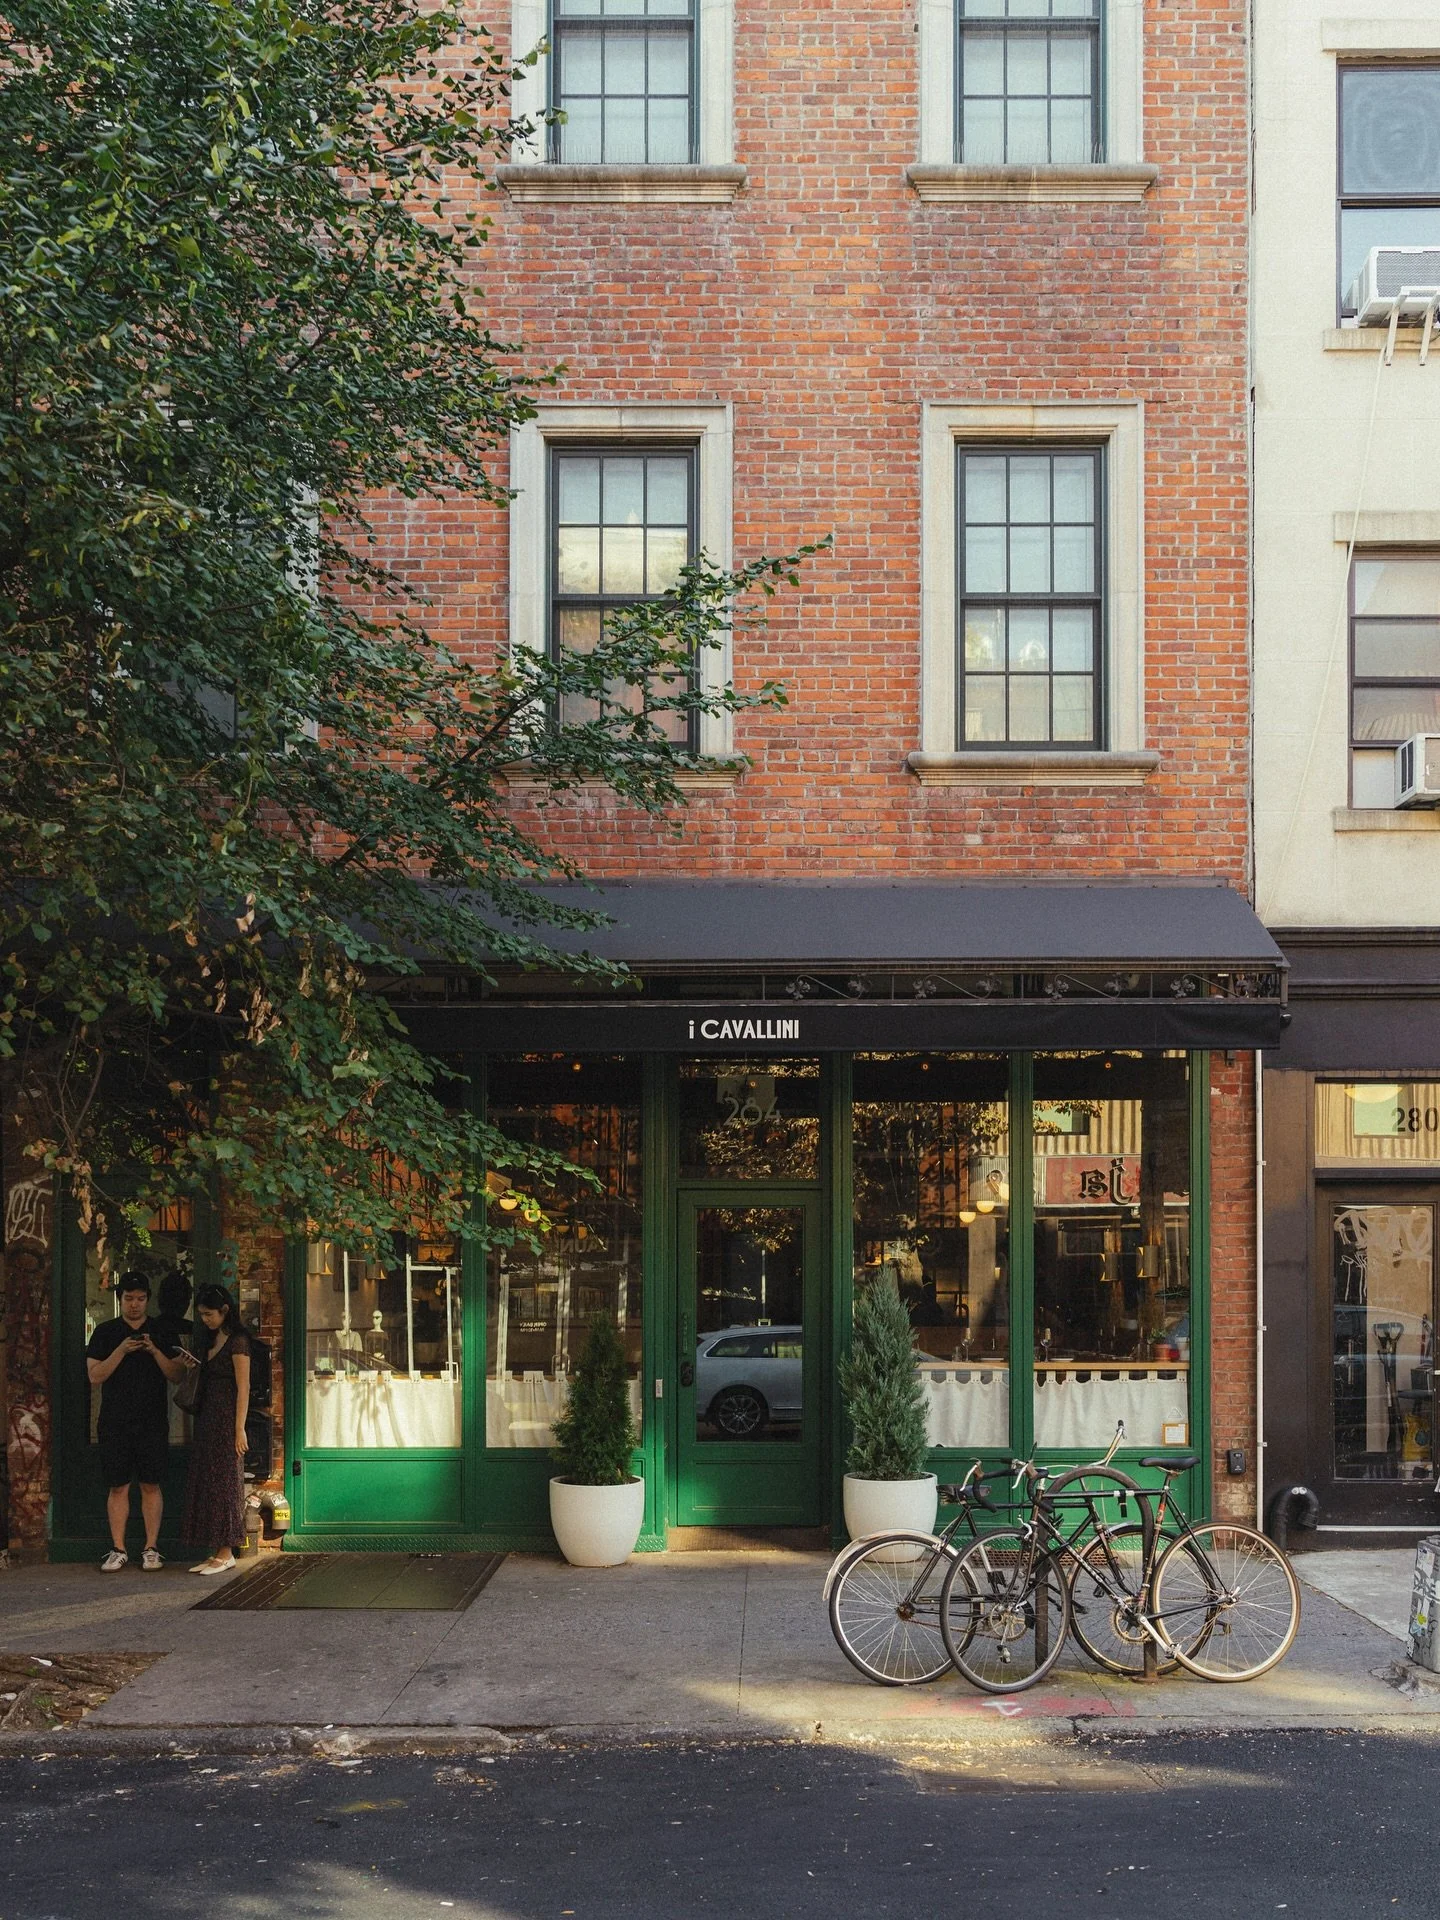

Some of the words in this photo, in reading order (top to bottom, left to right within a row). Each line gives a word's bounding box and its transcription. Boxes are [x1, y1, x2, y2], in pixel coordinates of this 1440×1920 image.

[688, 1019, 695, 1040] i
[700, 1019, 800, 1040] CAVALLINI
[723, 1096, 782, 1126] 284
[1391, 1107, 1439, 1133] 280
